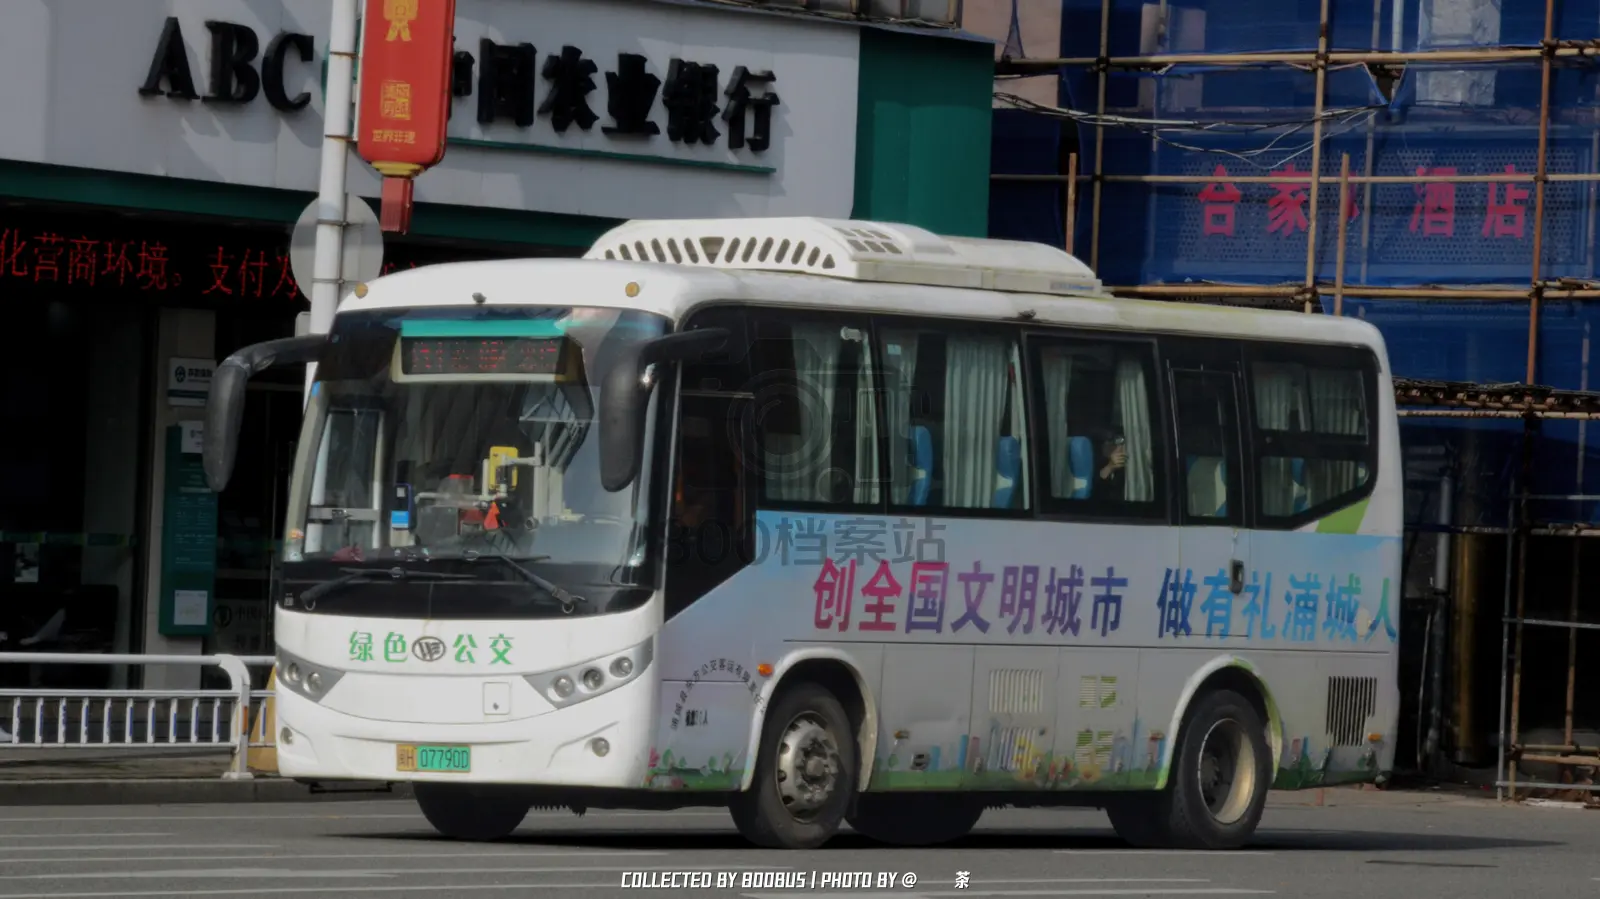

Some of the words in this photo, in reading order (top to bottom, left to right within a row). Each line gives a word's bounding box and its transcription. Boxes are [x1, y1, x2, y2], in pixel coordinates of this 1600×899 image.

[138, 16, 315, 112] ABC
[1198, 163, 1530, 239] 合家酒店
[812, 558, 1129, 637] 创全国文明城市
[1156, 567, 1397, 643] 做有礼浦城人
[348, 630, 408, 663] 绿色
[452, 633, 515, 665] 公交
